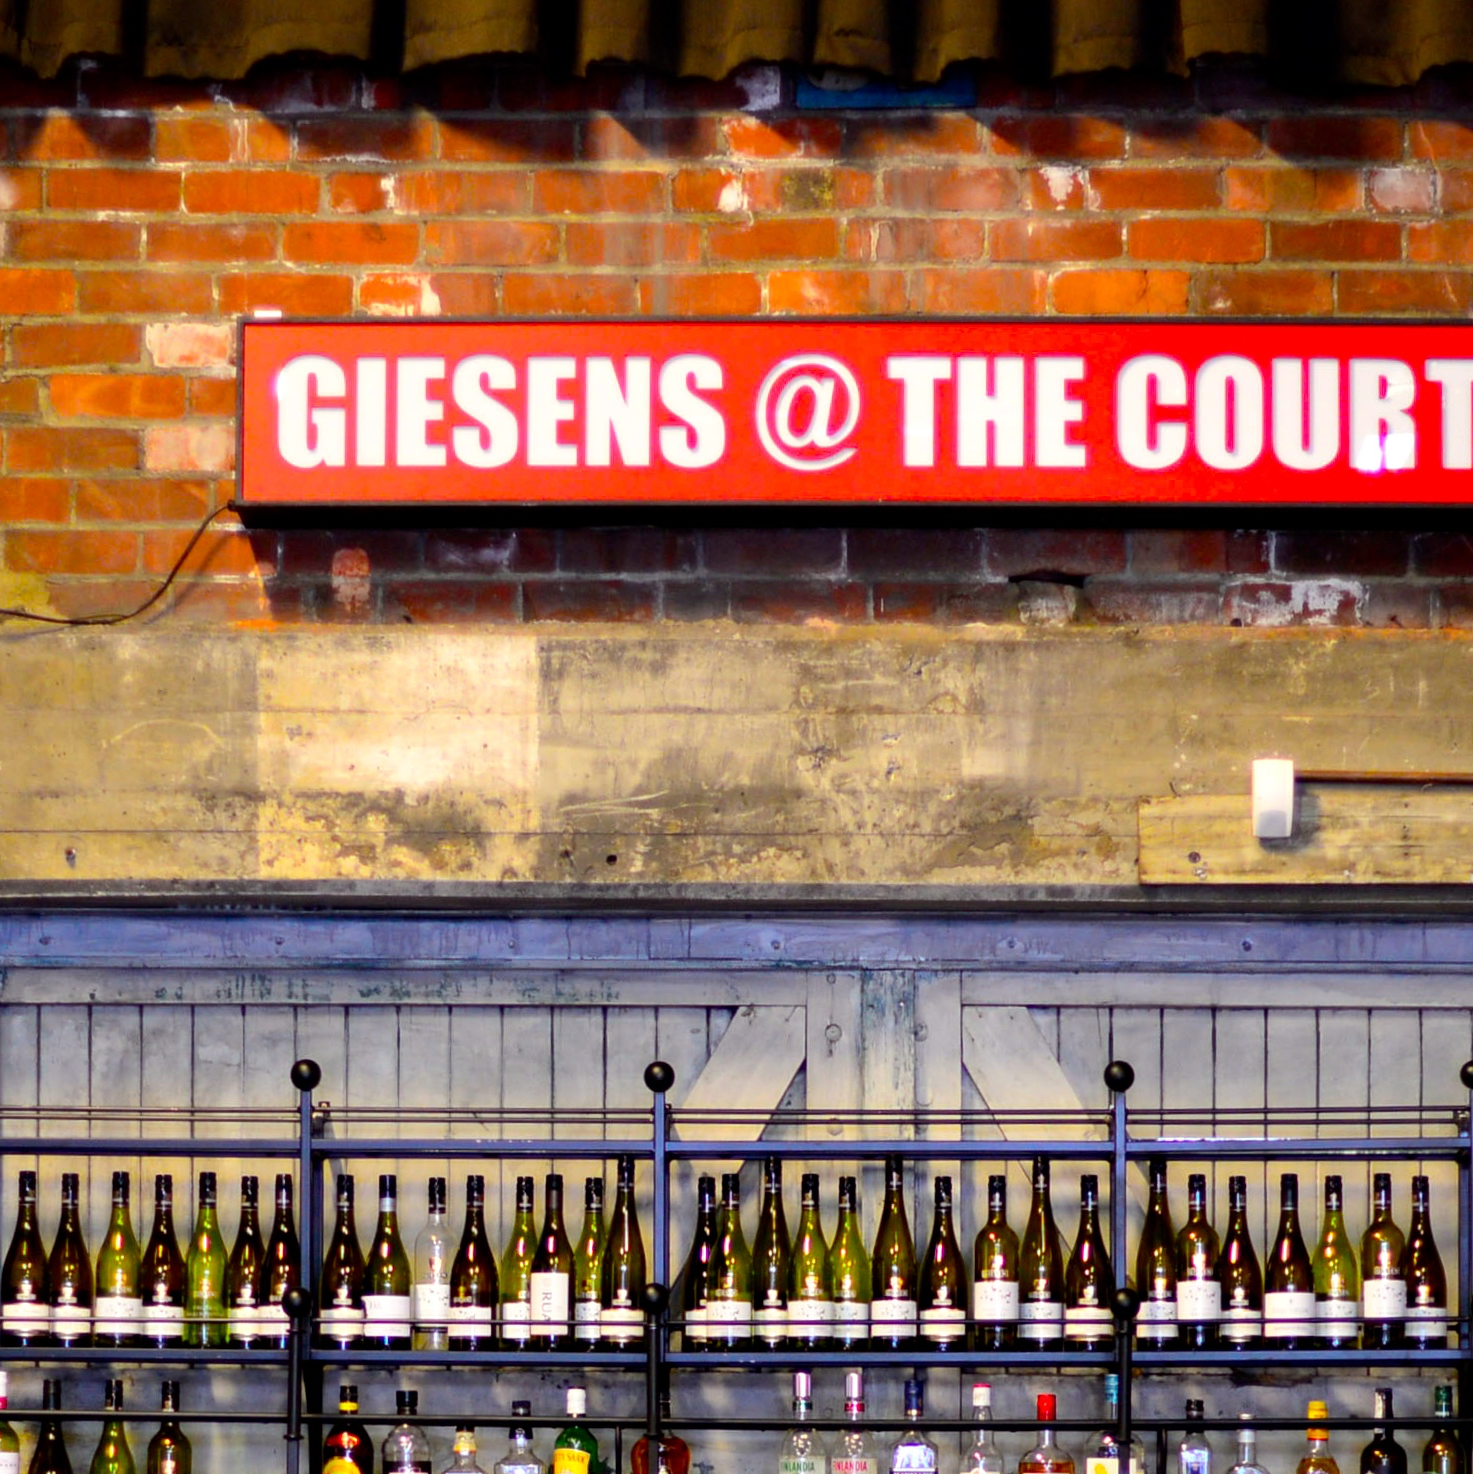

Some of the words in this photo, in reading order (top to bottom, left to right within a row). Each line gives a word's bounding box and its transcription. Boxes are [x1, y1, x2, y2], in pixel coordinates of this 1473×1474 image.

[274, 353, 726, 470] GIESENS
[755, 353, 861, 472] @
[887, 356, 1088, 469] THE
